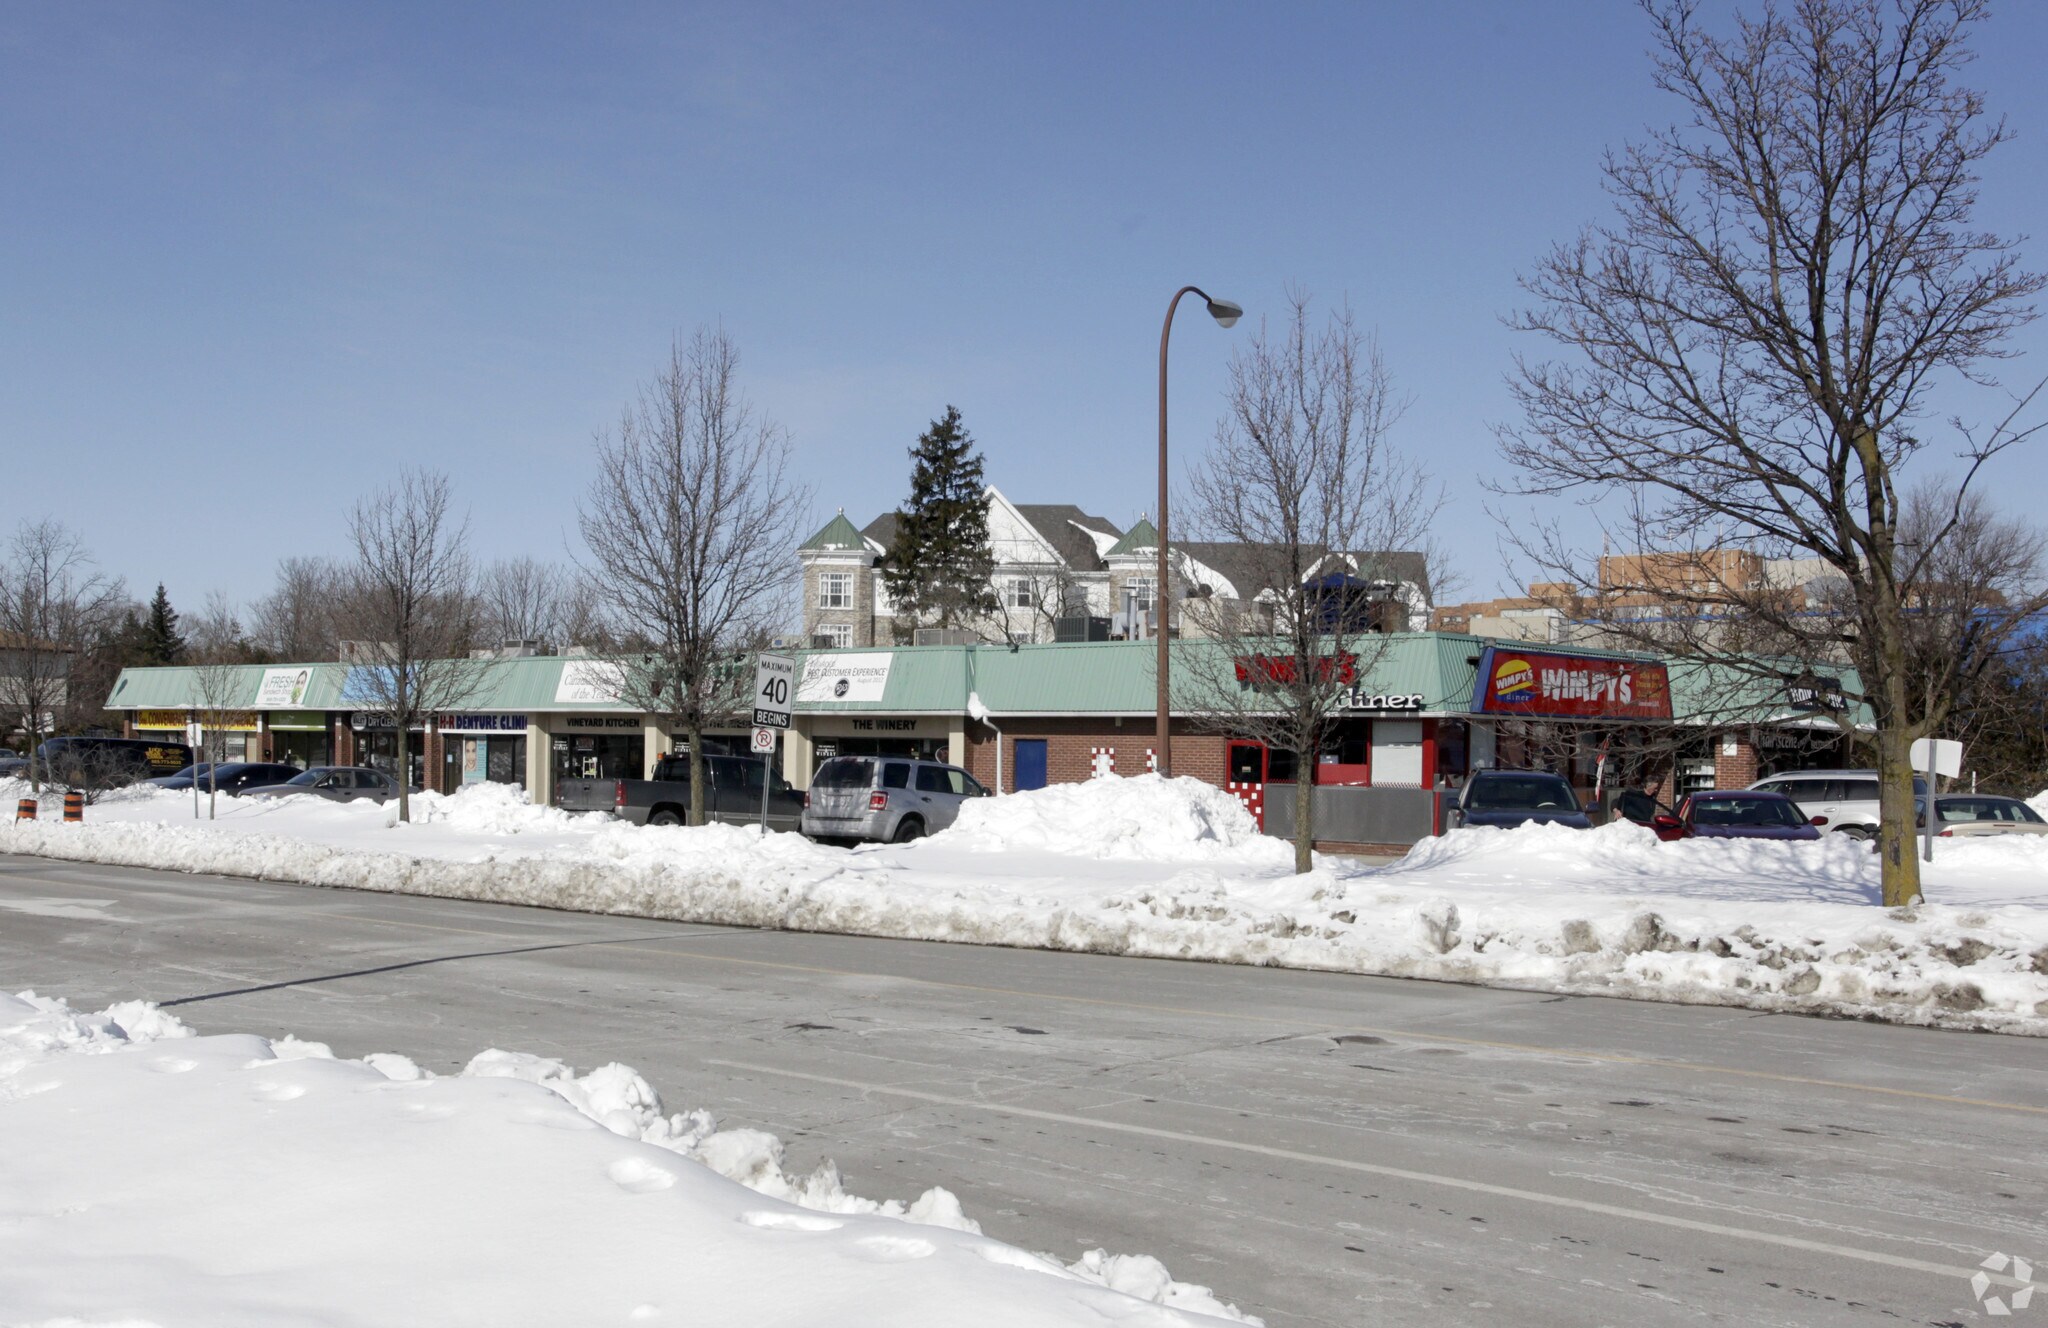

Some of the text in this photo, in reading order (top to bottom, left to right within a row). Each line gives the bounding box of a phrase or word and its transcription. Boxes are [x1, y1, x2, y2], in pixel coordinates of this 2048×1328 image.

[761, 660, 792, 674] MAXIMUM
[822, 668, 851, 677] CUSTOMER
[852, 667, 887, 677] EXPERIENCE
[270, 675, 296, 689] FRESH
[1496, 668, 1534, 690] WIMPY'S
[1540, 664, 1632, 705] WIMPY'S
[762, 676, 788, 705] 40
[1506, 693, 1530, 701] diner
[1337, 688, 1423, 709] diner
[368, 716, 379, 727] DRY
[456, 714, 497, 730] DENTURE
[566, 717, 640, 728] VINEYARD KITCHEN
[756, 710, 788, 727] BEGINS
[852, 719, 917, 730] THE WINERY
